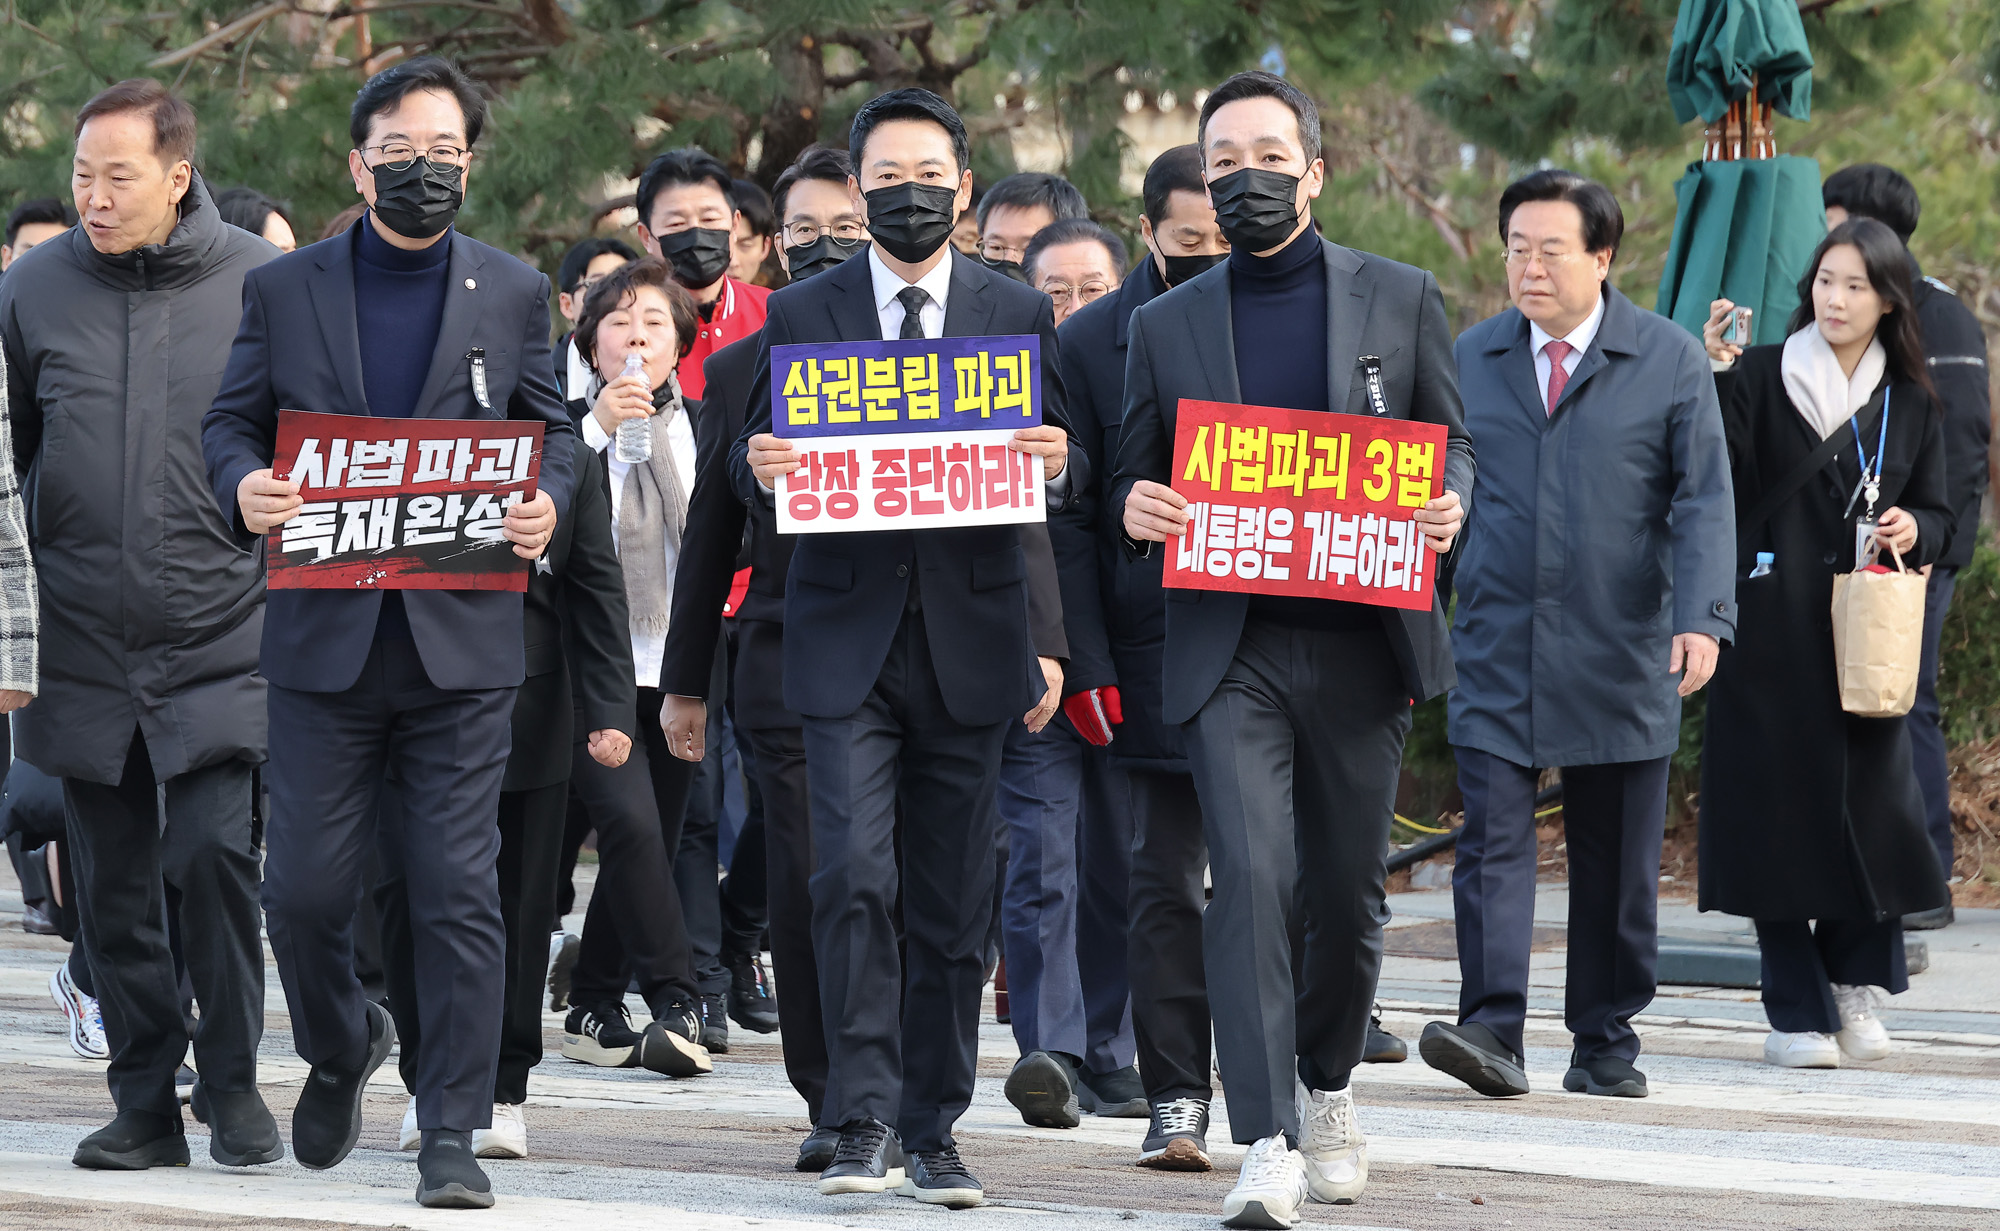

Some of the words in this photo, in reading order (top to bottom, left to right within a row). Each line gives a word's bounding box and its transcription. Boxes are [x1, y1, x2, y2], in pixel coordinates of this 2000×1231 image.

[782, 353, 940, 426] 삼권분립
[953, 349, 1032, 419] 파괴
[289, 438, 409, 489] 사법
[412, 436, 535, 485] 파괴
[786, 449, 860, 521] 당장
[872, 443, 1034, 518] 중단하라!
[1183, 421, 1351, 500] 사법파괴
[1362, 438, 1435, 509] 3법
[281, 497, 399, 559] 독재
[1176, 501, 1294, 581] 대통령은
[1303, 510, 1426, 592] 거부하라!
